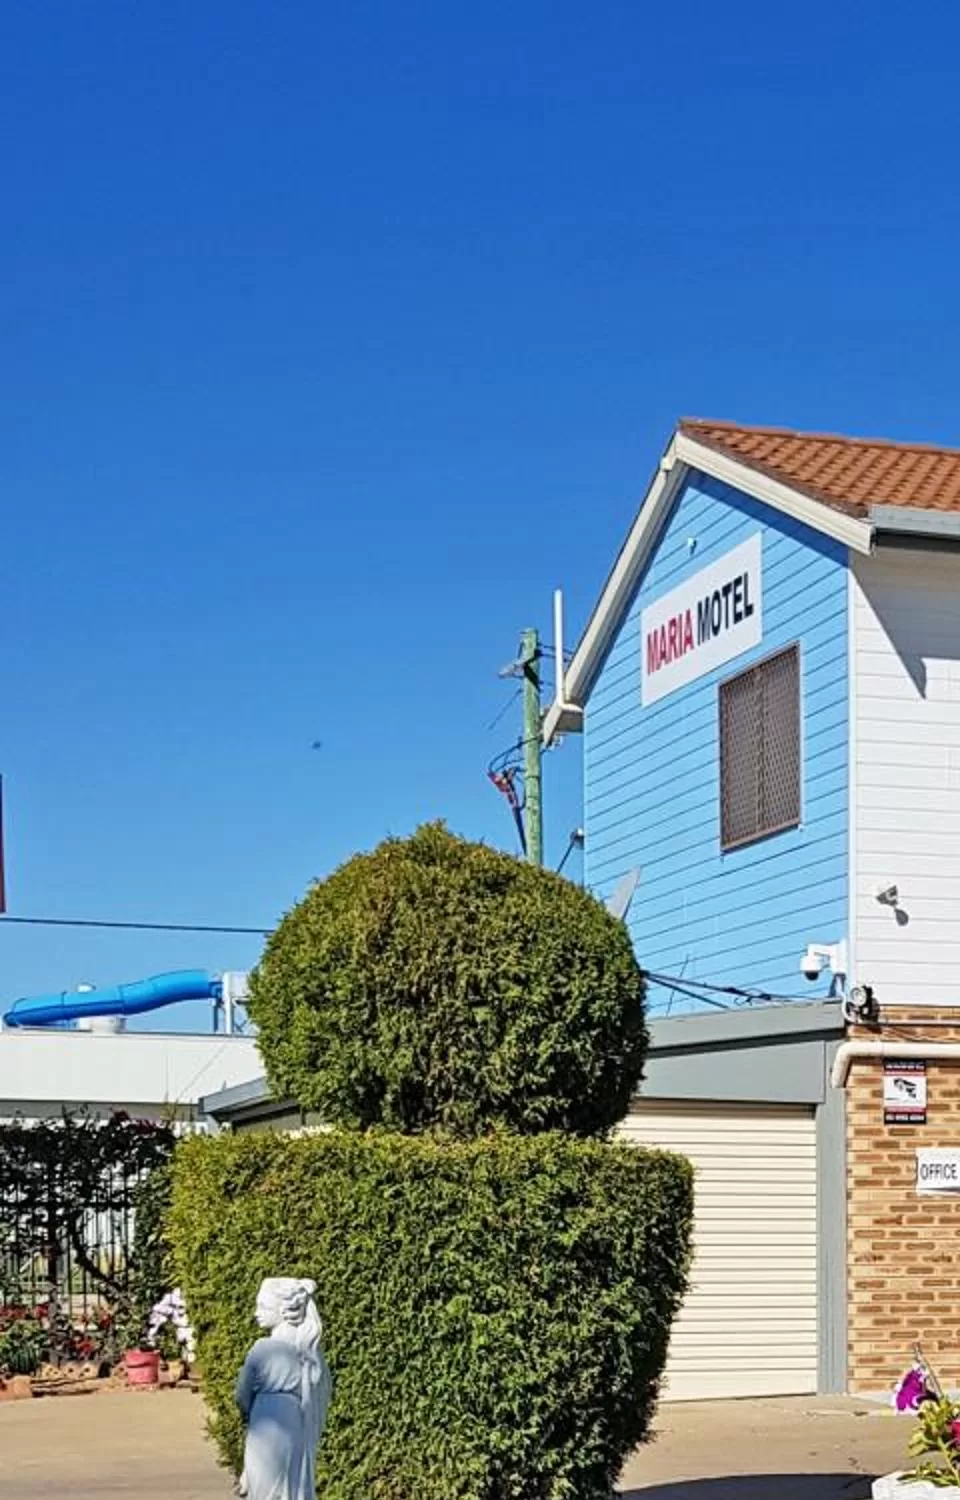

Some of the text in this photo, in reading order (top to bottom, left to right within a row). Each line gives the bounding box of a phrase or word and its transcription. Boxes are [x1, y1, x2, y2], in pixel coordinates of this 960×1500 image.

[647, 572, 754, 676] MARIA MOTEL
[920, 1162, 958, 1181] OFFICE
